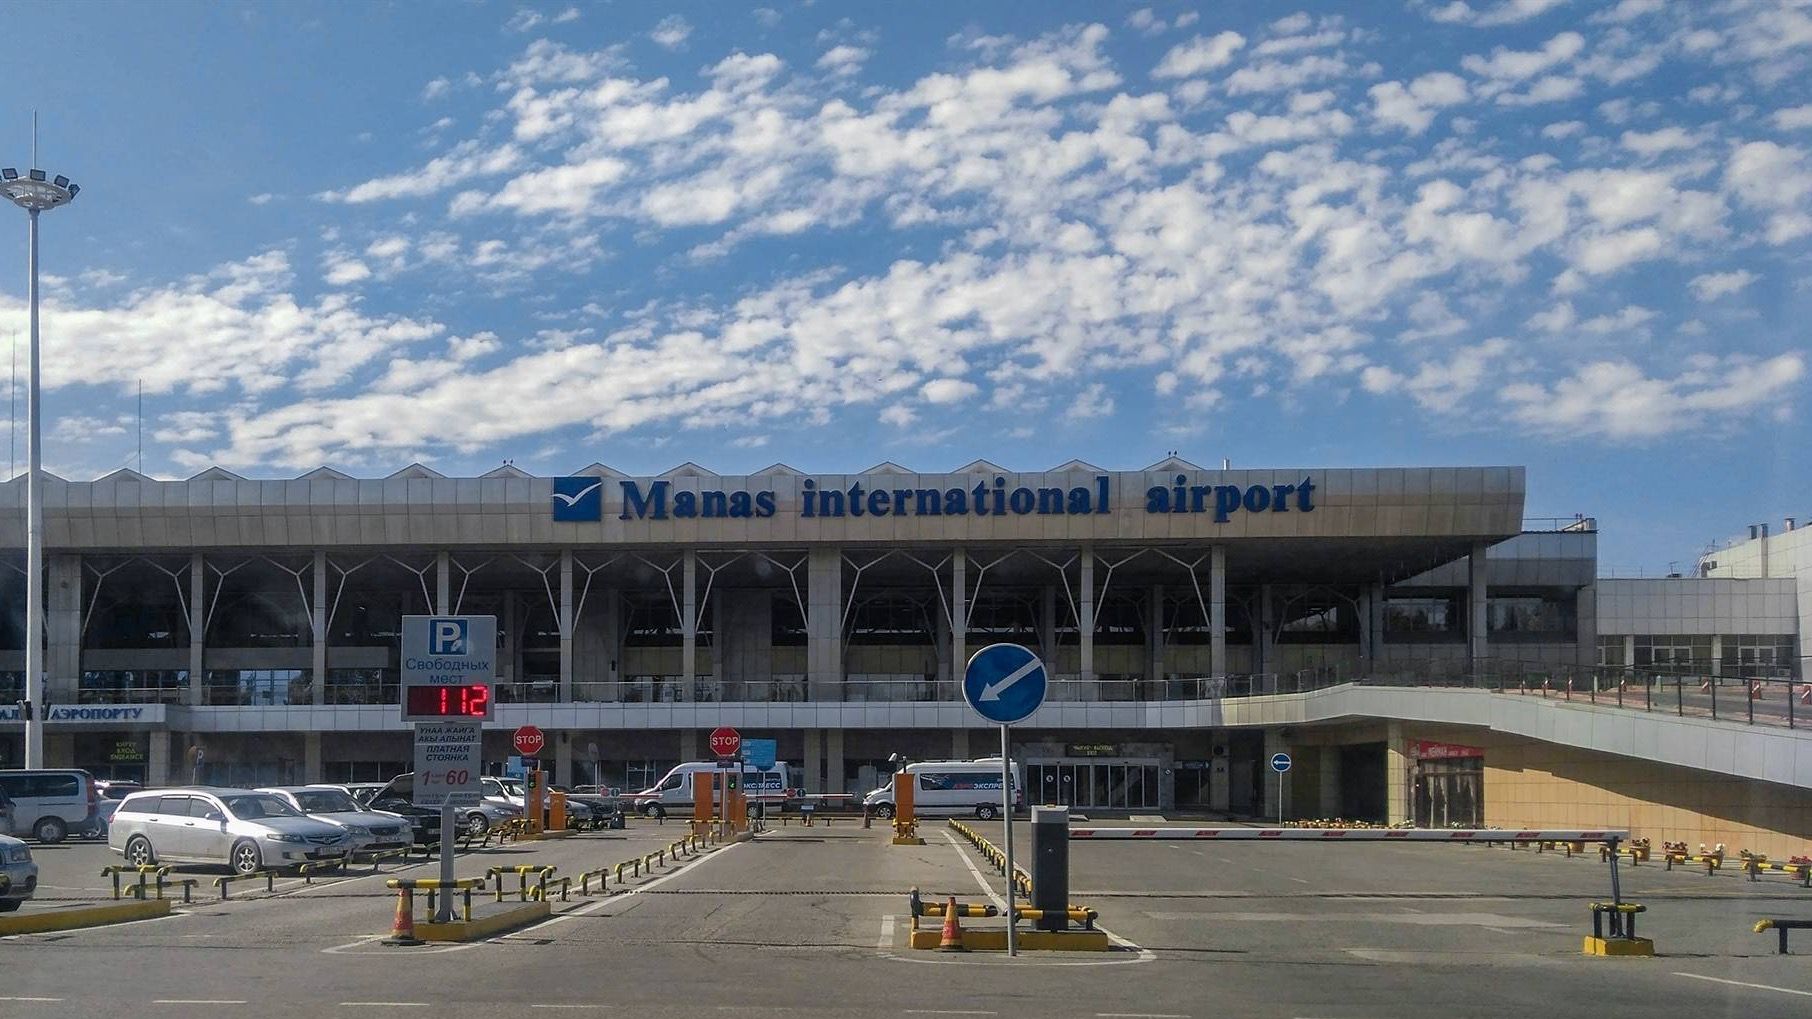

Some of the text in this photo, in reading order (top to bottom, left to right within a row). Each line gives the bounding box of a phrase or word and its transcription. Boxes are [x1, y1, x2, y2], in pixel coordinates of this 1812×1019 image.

[618, 474, 1316, 523] Manas international airport
[406, 658, 489, 672] Свободных
[429, 674, 466, 684] мест
[440, 686, 488, 715] 112
[51, 708, 144, 720] АЭРОПОРТУ
[516, 735, 542, 745] STOP
[712, 736, 739, 746] STOP
[426, 745, 470, 753] ПЛАТНАЯ
[446, 769, 469, 785] 60
